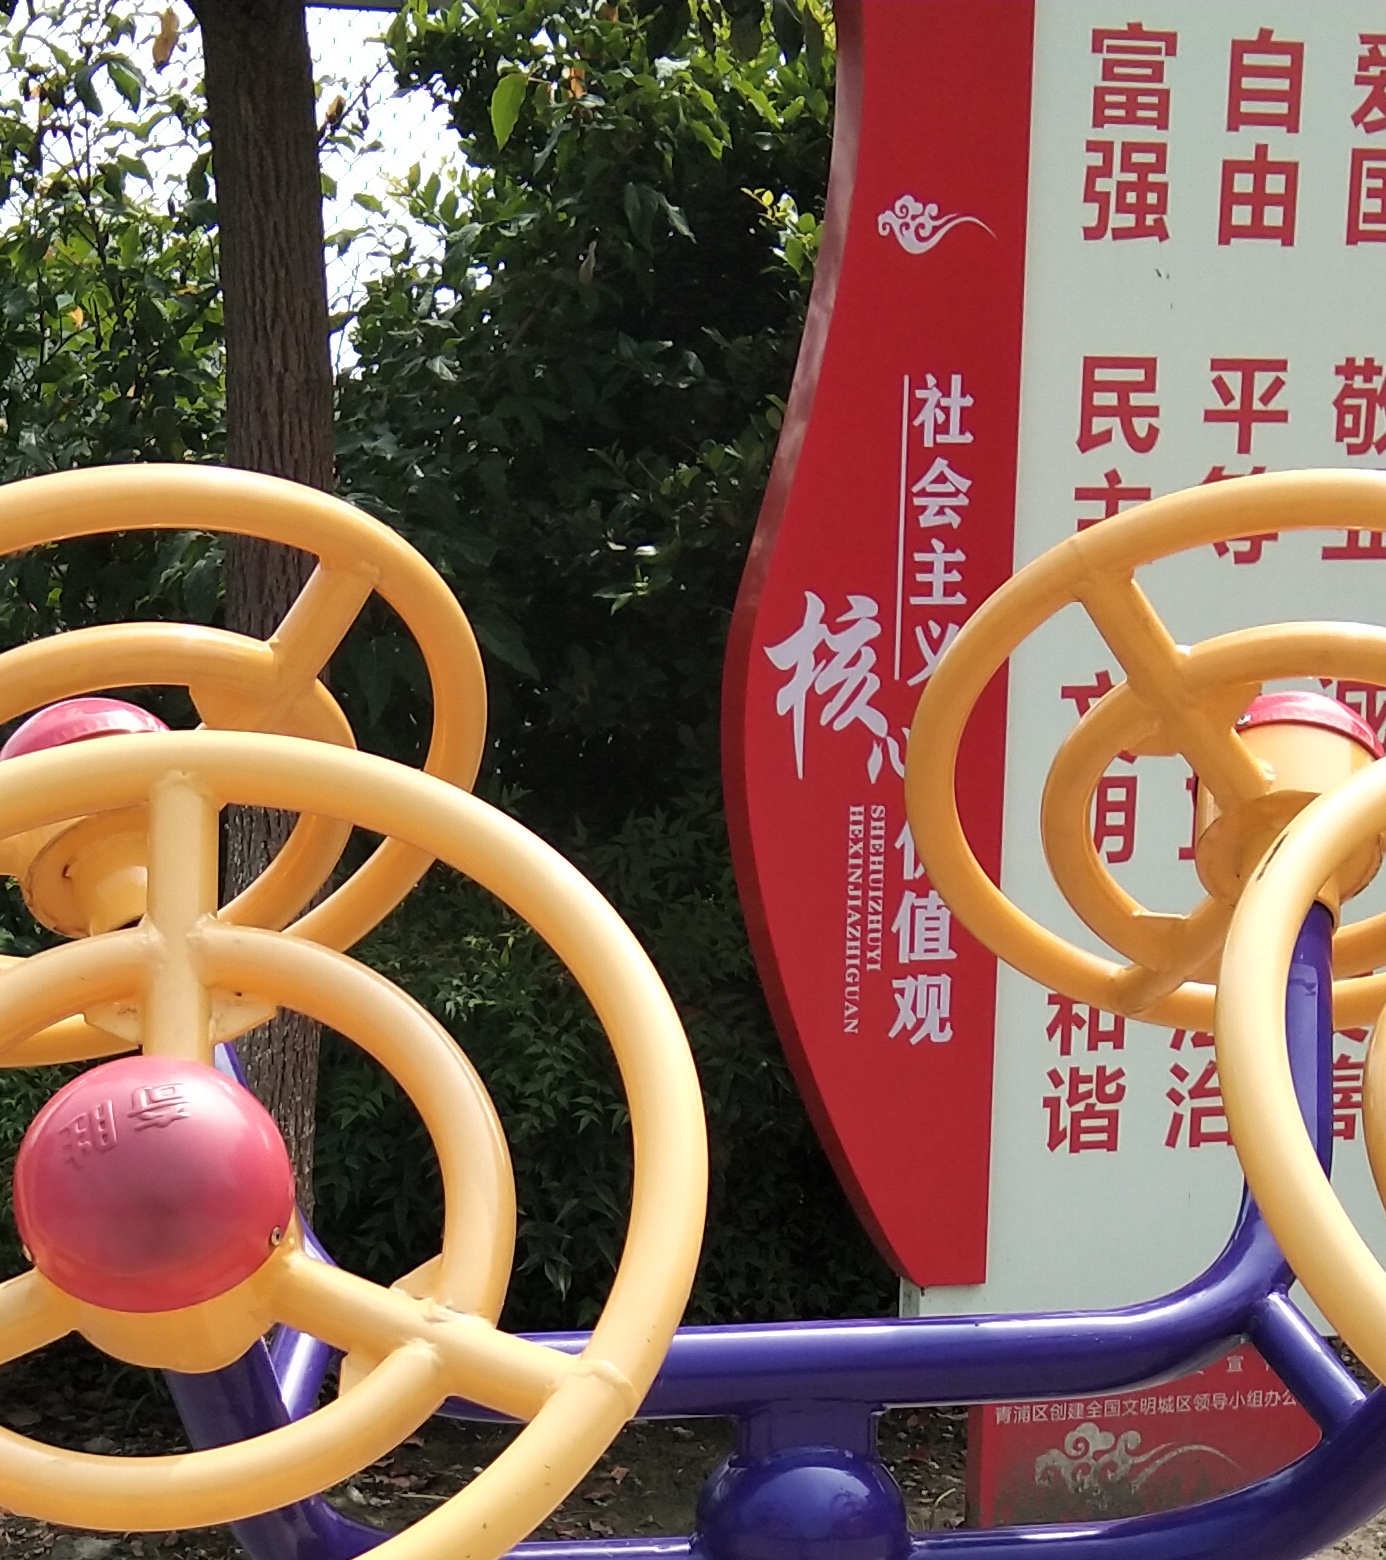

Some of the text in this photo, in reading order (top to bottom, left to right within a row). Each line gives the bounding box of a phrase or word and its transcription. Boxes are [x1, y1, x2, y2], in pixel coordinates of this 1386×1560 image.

[1082, 22, 1178, 243] 富强
[1217, 27, 1305, 248] 自由
[843, 805, 864, 1034] HEXINJIAZHIGUAN
[866, 805, 885, 972] SHEHUIZHUYI
[1042, 992, 1127, 1154] 和谐
